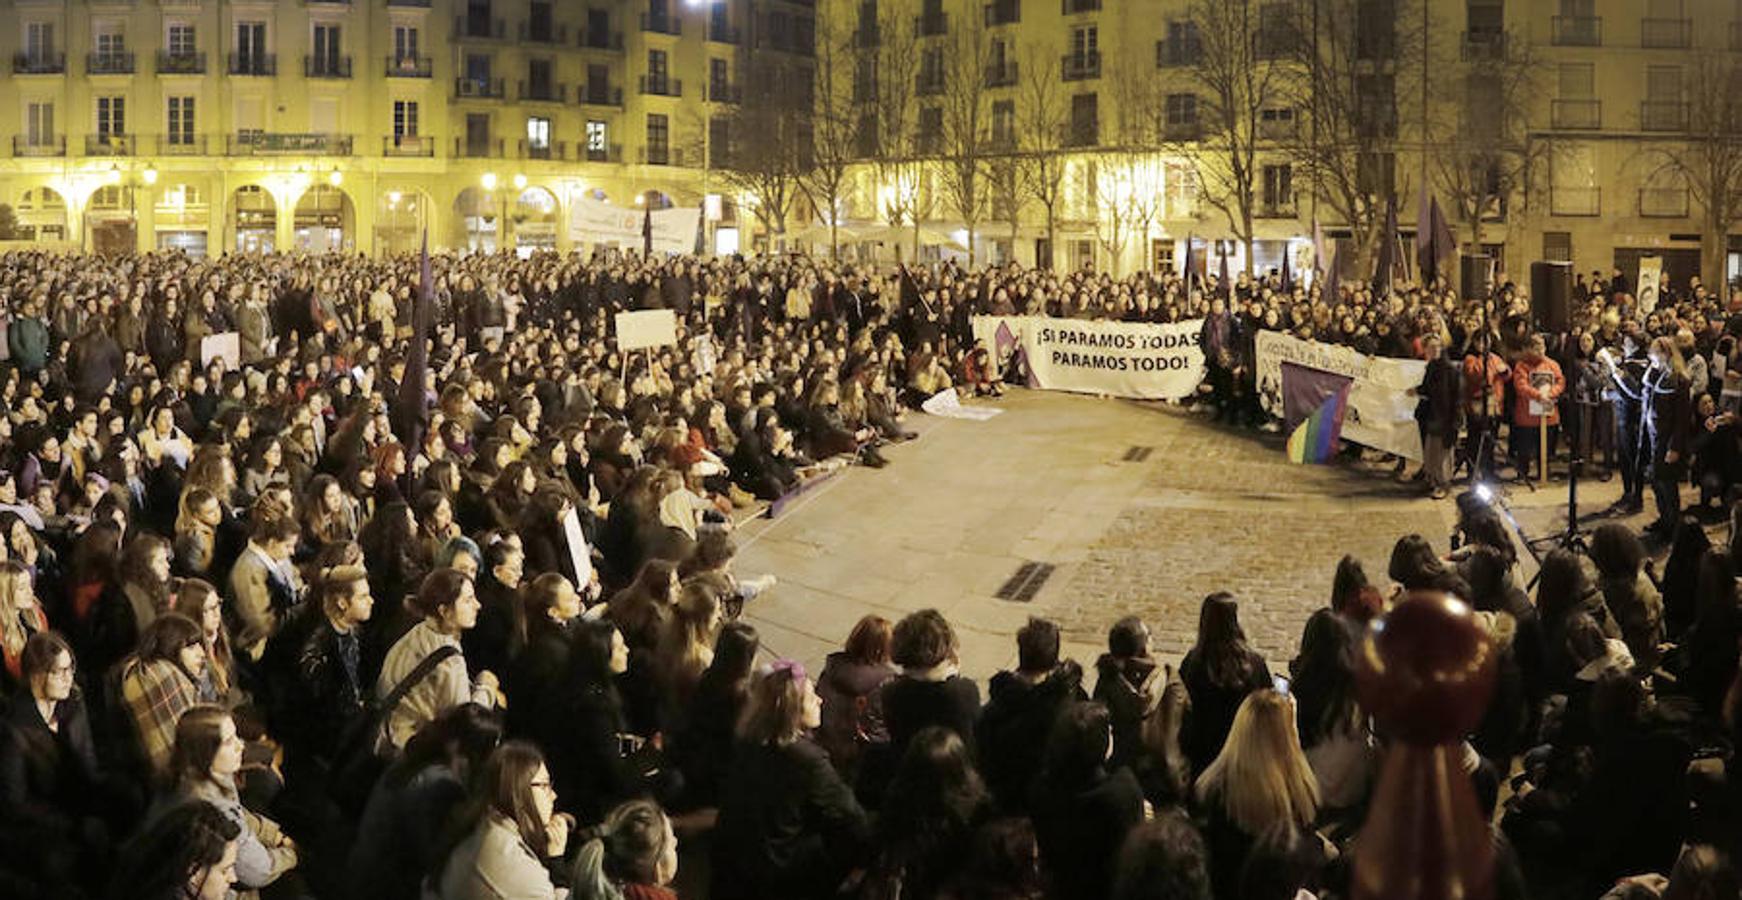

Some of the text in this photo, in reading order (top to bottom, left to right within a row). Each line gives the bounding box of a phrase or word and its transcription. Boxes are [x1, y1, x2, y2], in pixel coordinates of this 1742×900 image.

[1059, 330, 1136, 349] PARAMOS
[1140, 332, 1201, 349] TODAS
[1052, 351, 1190, 372] PARAMOS TODO!
